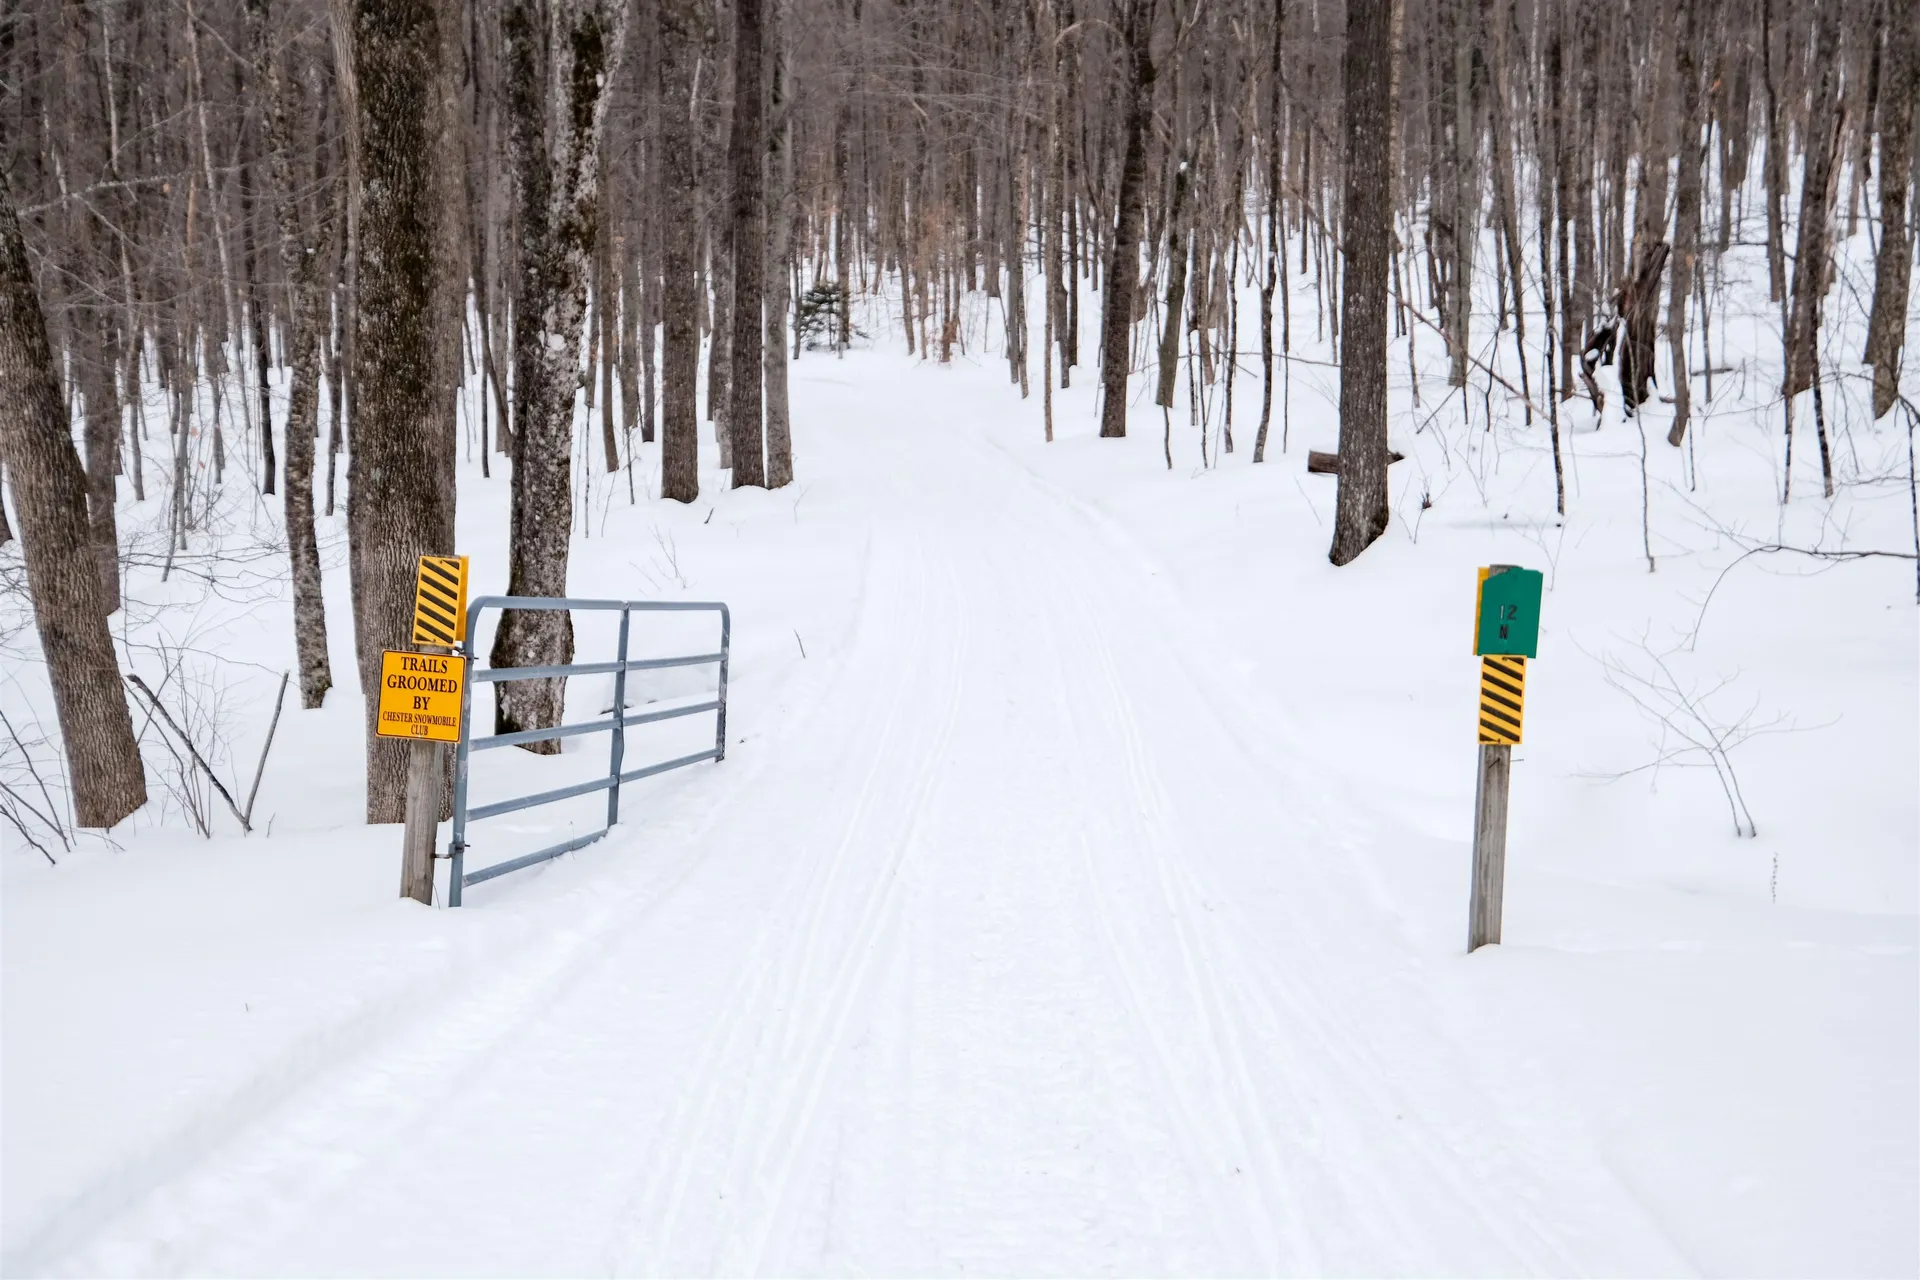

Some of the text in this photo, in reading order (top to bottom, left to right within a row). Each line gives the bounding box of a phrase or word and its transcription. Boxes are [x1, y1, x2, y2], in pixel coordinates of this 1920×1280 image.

[1499, 604, 1518, 621] 12
[1499, 624, 1509, 640] N
[401, 656, 448, 674] TRAILS
[387, 674, 458, 693] GROOMED
[413, 695, 431, 710] BY
[382, 710, 456, 727] CHESTER SNOWMOBILE
[410, 724, 429, 736] CLUB
